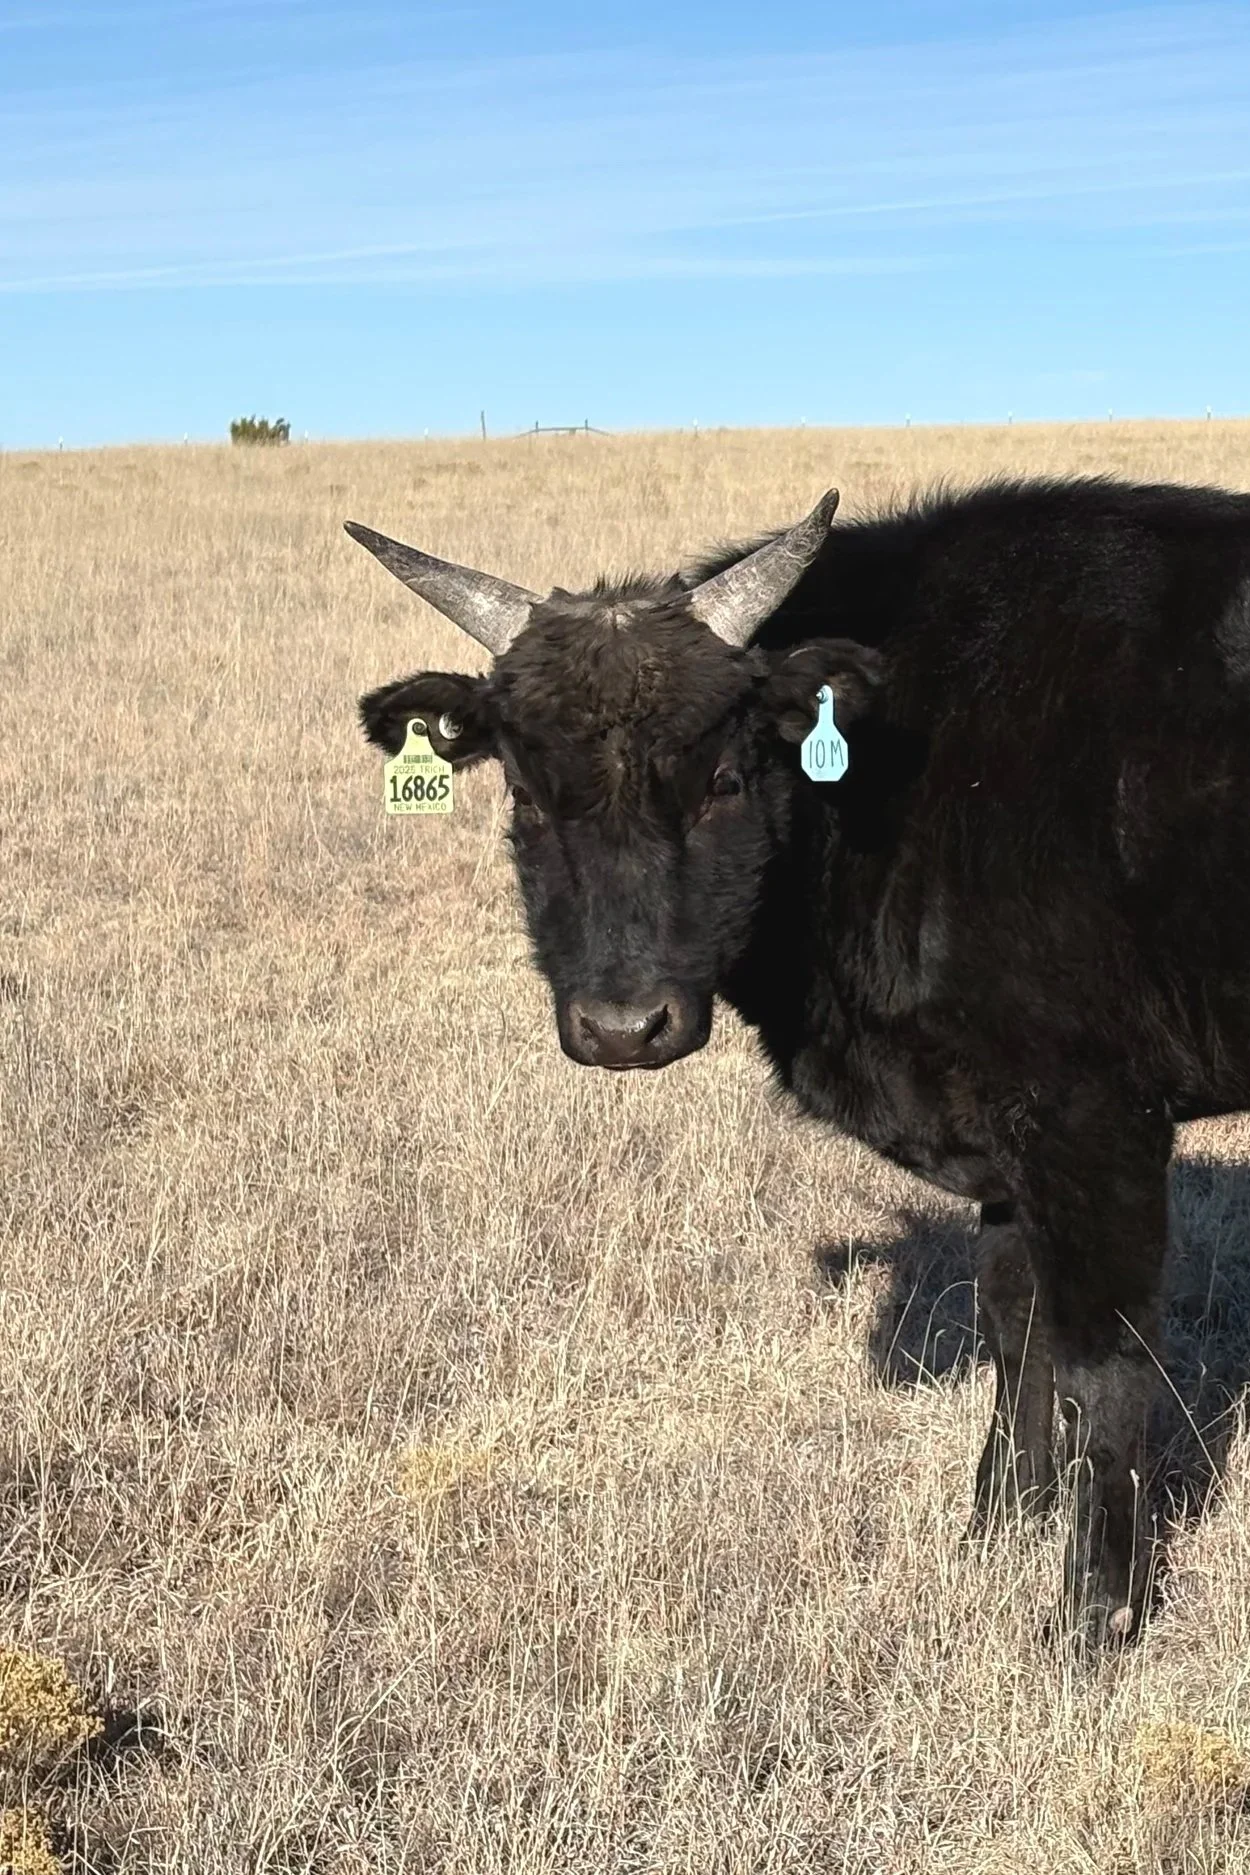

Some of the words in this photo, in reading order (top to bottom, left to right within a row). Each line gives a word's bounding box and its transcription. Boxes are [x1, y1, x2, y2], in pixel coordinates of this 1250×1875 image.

[393, 765, 416, 774] 2025
[420, 765, 445, 774] TRICH
[389, 774, 450, 802] 16865
[393, 803, 413, 811] NEW
[415, 803, 447, 811] MEXICO
